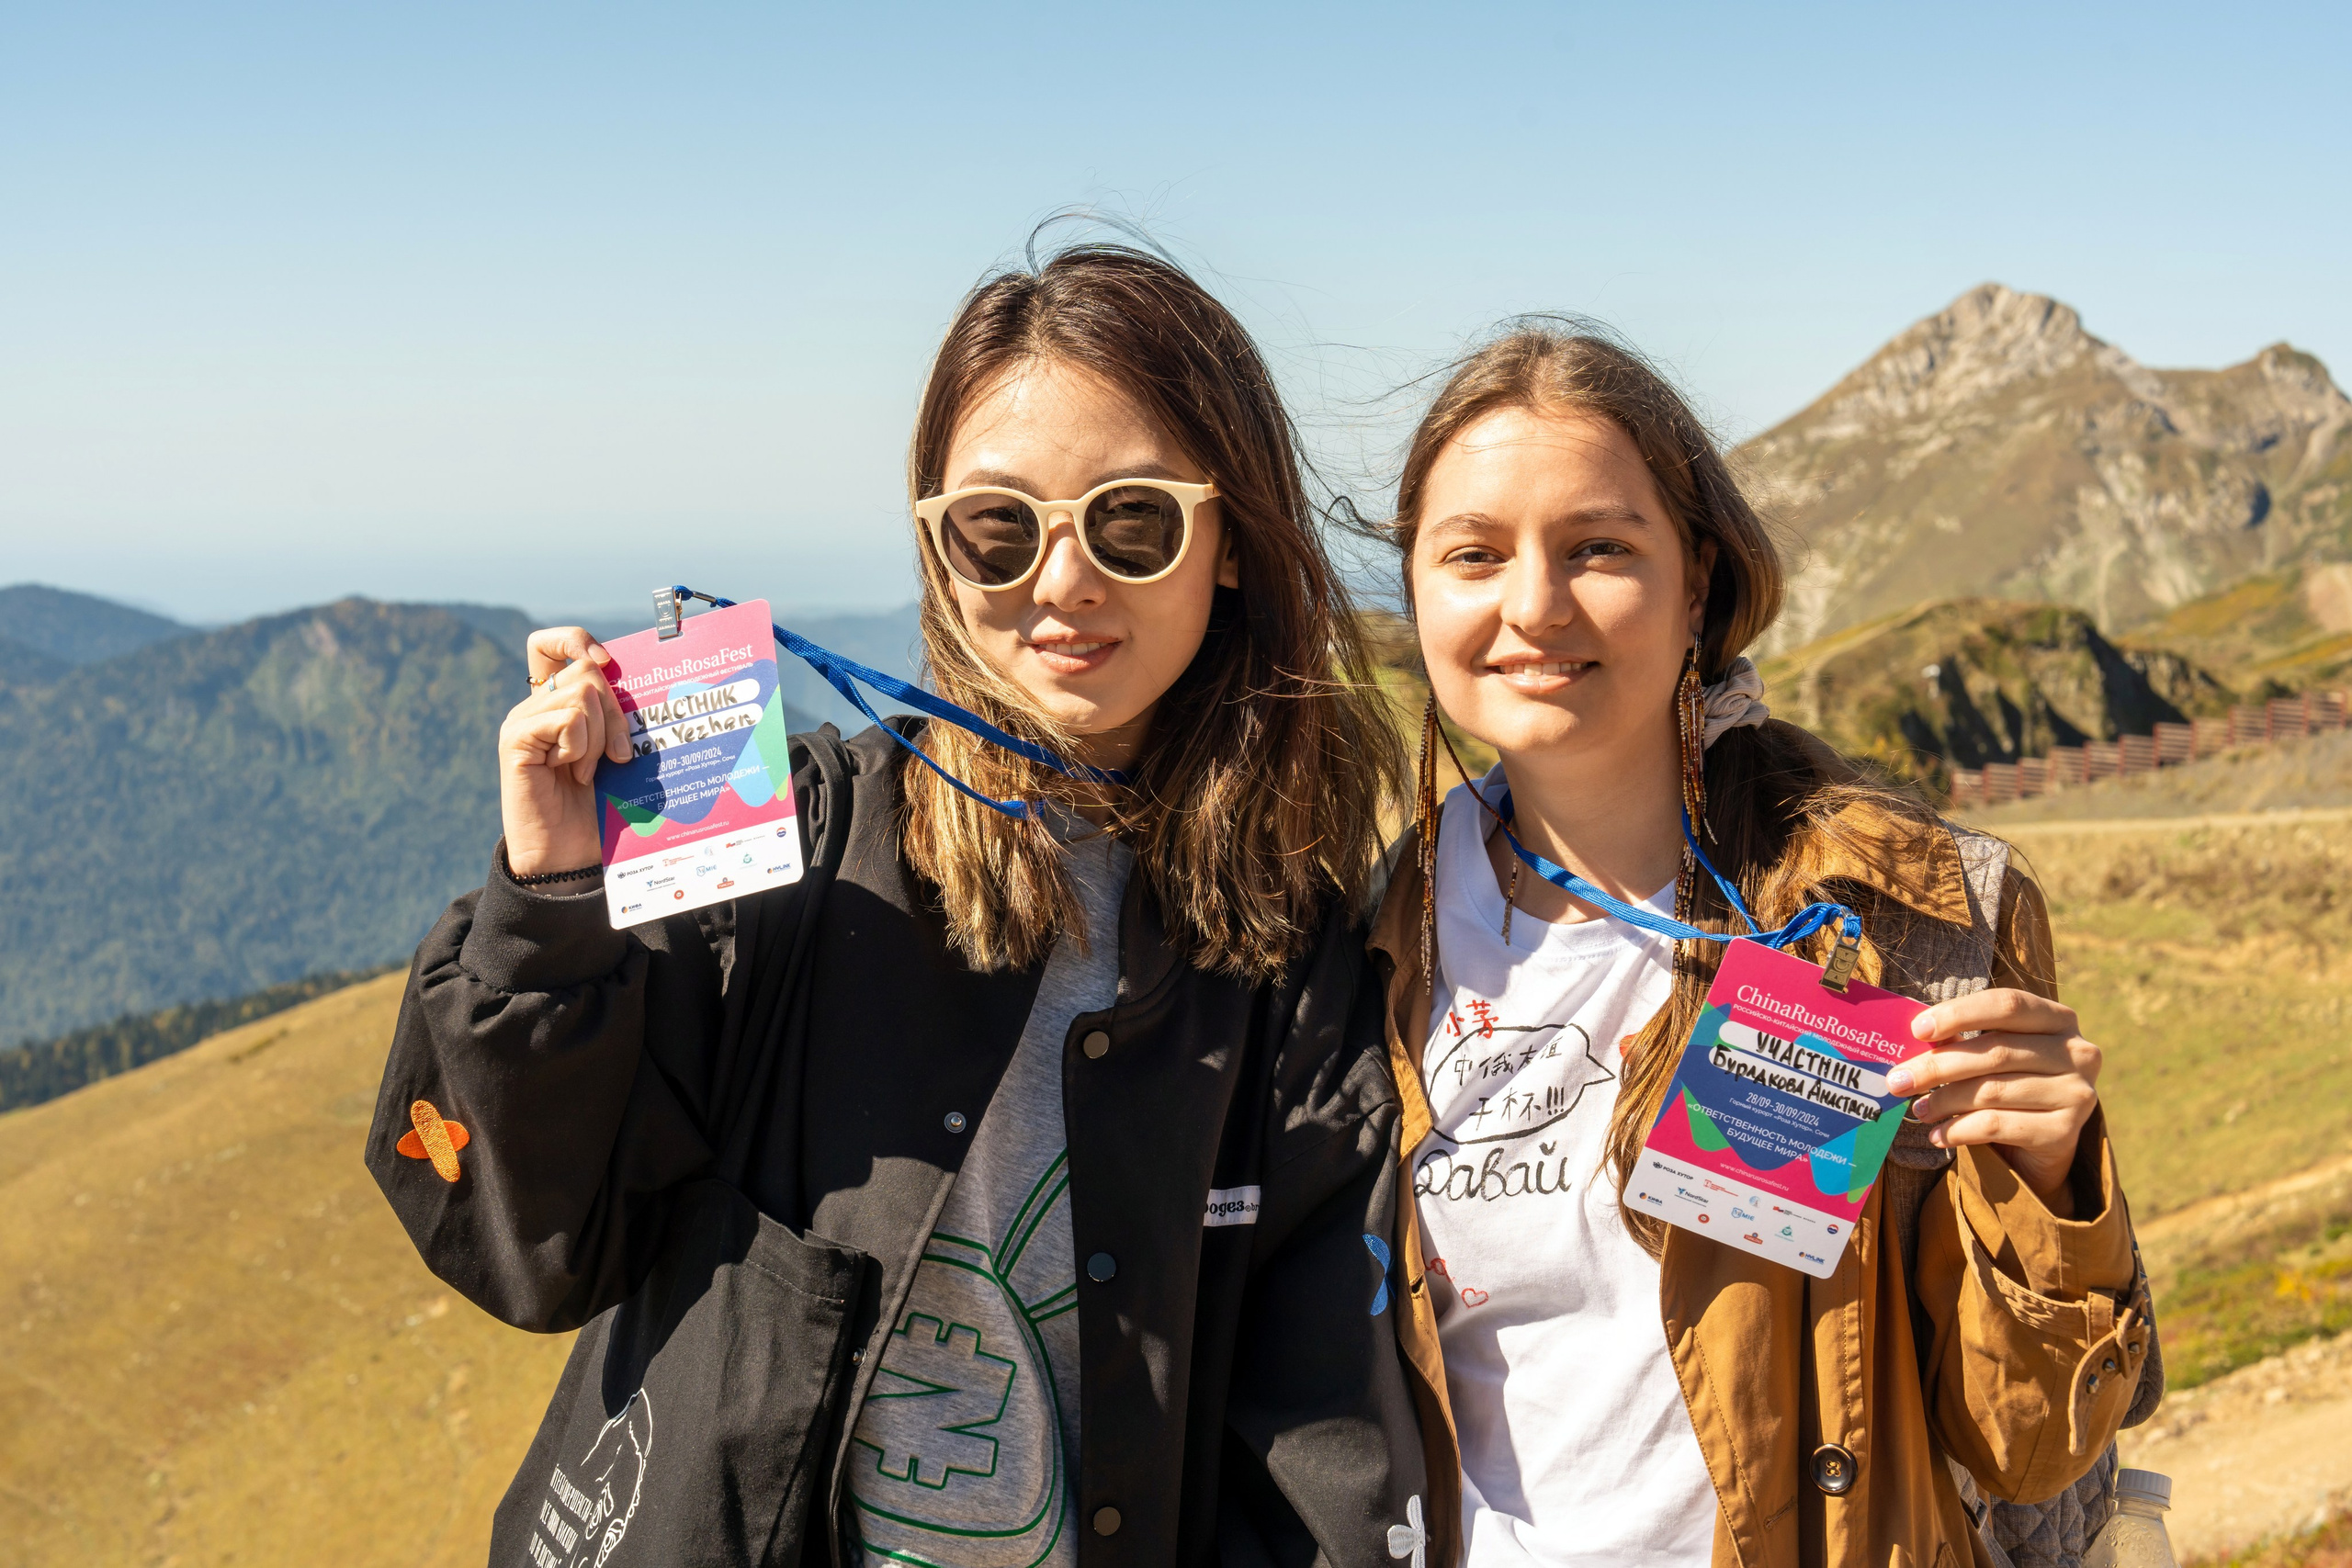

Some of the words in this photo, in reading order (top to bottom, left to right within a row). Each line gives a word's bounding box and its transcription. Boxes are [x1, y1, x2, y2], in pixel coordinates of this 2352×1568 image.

[719, 661, 754, 675] ФЕСТИВАЛЬ
[633, 684, 738, 731] УЧАСТНИК
[617, 780, 706, 810] «ОТВЕТСТВЕННОСТЬ
[707, 764, 761, 784] МОЛОДЕЖИ
[657, 794, 699, 811] БУДУЩЕЕ
[700, 785, 731, 798] МИРА»
[666, 820, 729, 841] www.chinarusrosafest.ru
[1733, 1003, 1812, 1036] РОССИЙСКО-КИТАЙСКИЙ
[1812, 1032, 1860, 1055] МОЛОДЕЖНЫЙ
[1736, 984, 1906, 1059] ChinaRusRosaFest
[1756, 1031, 1861, 1089] УЧАСТНИК
[1729, 1097, 1751, 1111] Горный
[1752, 1106, 1773, 1120] курорт
[1815, 1129, 1830, 1139] Сочи
[1746, 1091, 1820, 1127] 28/09-30/09/2024
[1687, 1102, 1788, 1145] «ОТВЕТСТВЕННОСТЬ
[1788, 1138, 1848, 1166] МОЛОДЕЖИ
[1726, 1127, 1774, 1152] БУДУЩЕЕ
[1774, 1145, 1809, 1164] МИРА»
[1662, 1166, 1677, 1176] РОЗА
[1676, 1170, 1694, 1181] ХУТОР
[1720, 1162, 1790, 1192] www.chinarusrosafest.ru
[1684, 1190, 1709, 1204] NordStar
